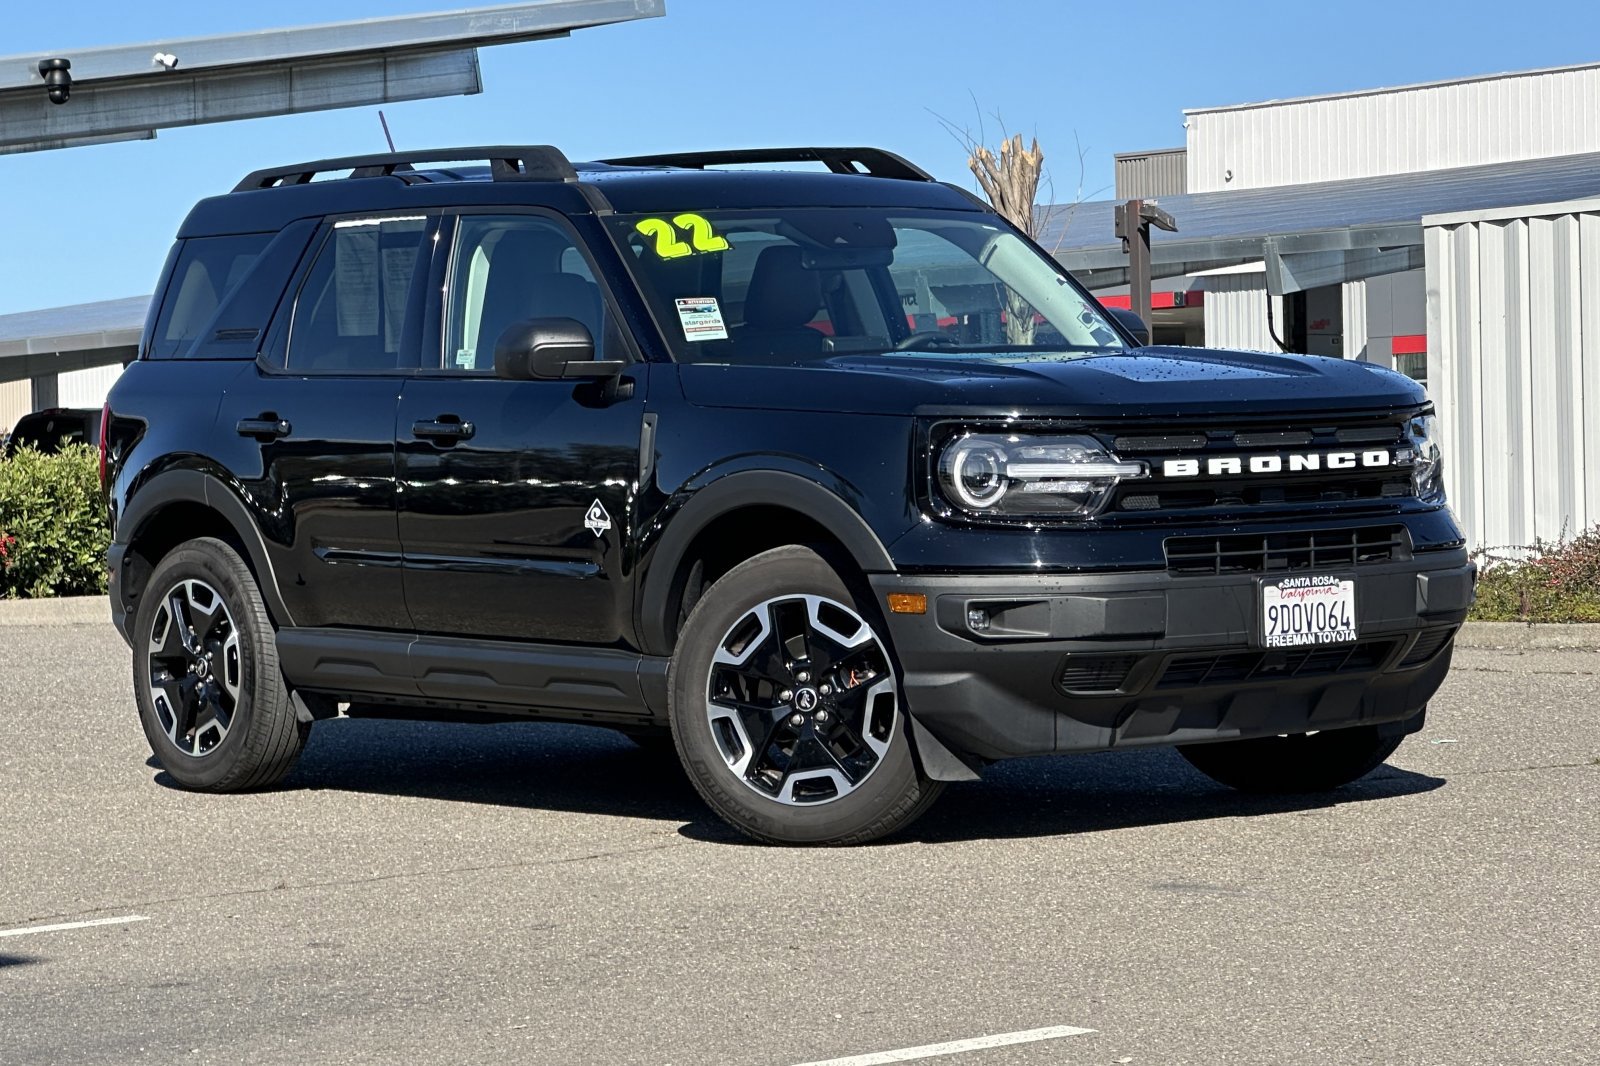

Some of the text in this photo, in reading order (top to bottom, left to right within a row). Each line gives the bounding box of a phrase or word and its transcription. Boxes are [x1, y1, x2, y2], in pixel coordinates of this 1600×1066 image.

[635, 213, 729, 257] 22
[1163, 450, 1390, 477] BRONCO
[1283, 575, 1335, 589] SANTA ROSA
[1280, 586, 1338, 603] California
[1266, 629, 1357, 648] FREEMAN TOYOTA
